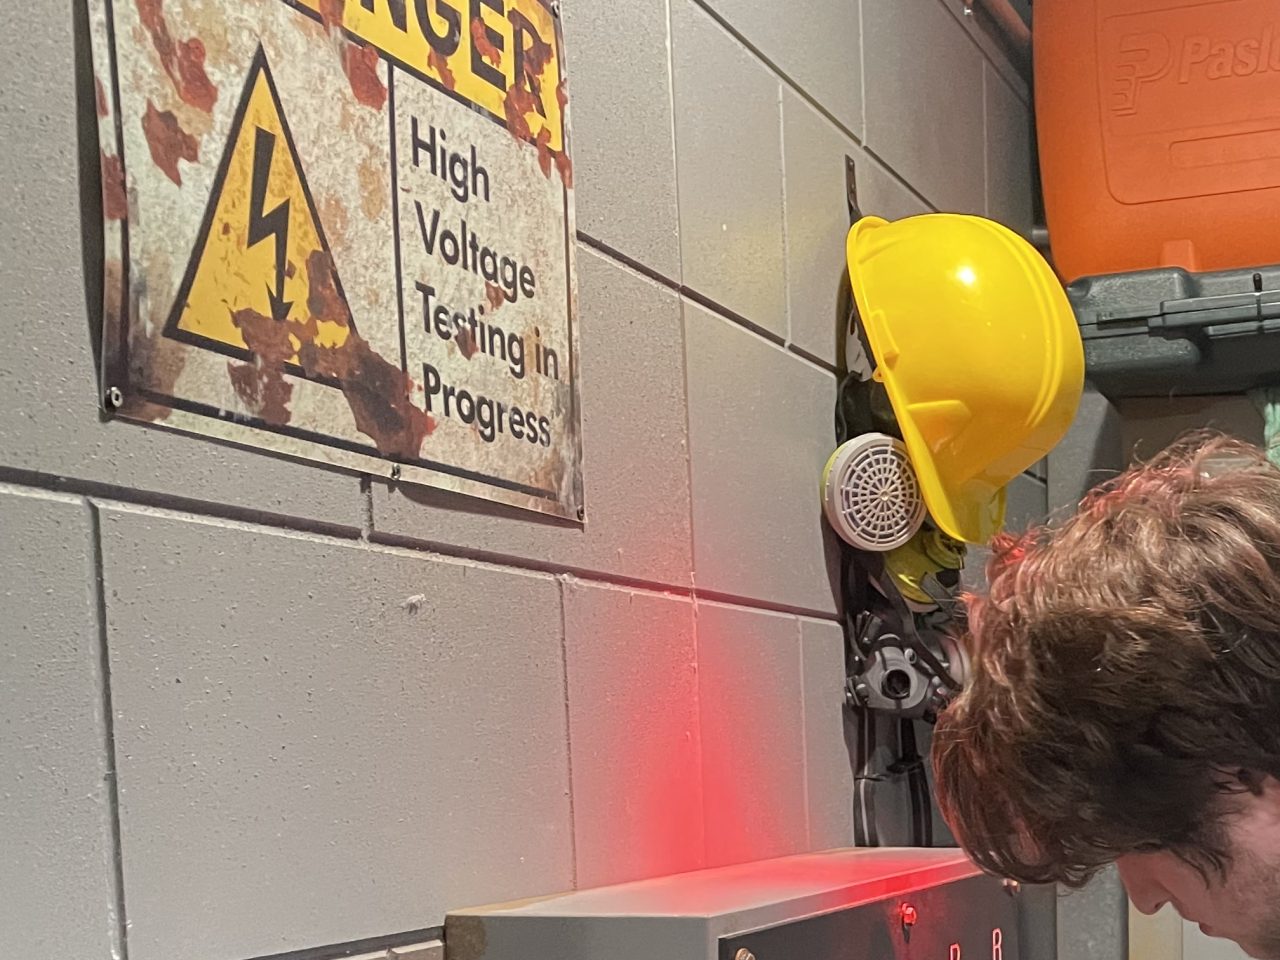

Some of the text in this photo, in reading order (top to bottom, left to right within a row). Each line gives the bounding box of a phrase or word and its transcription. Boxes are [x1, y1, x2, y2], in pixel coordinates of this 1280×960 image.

[411, 115, 490, 203] High
[414, 200, 535, 303] Voltage
[415, 280, 559, 380] Testing in
[422, 362, 551, 448] Progress
